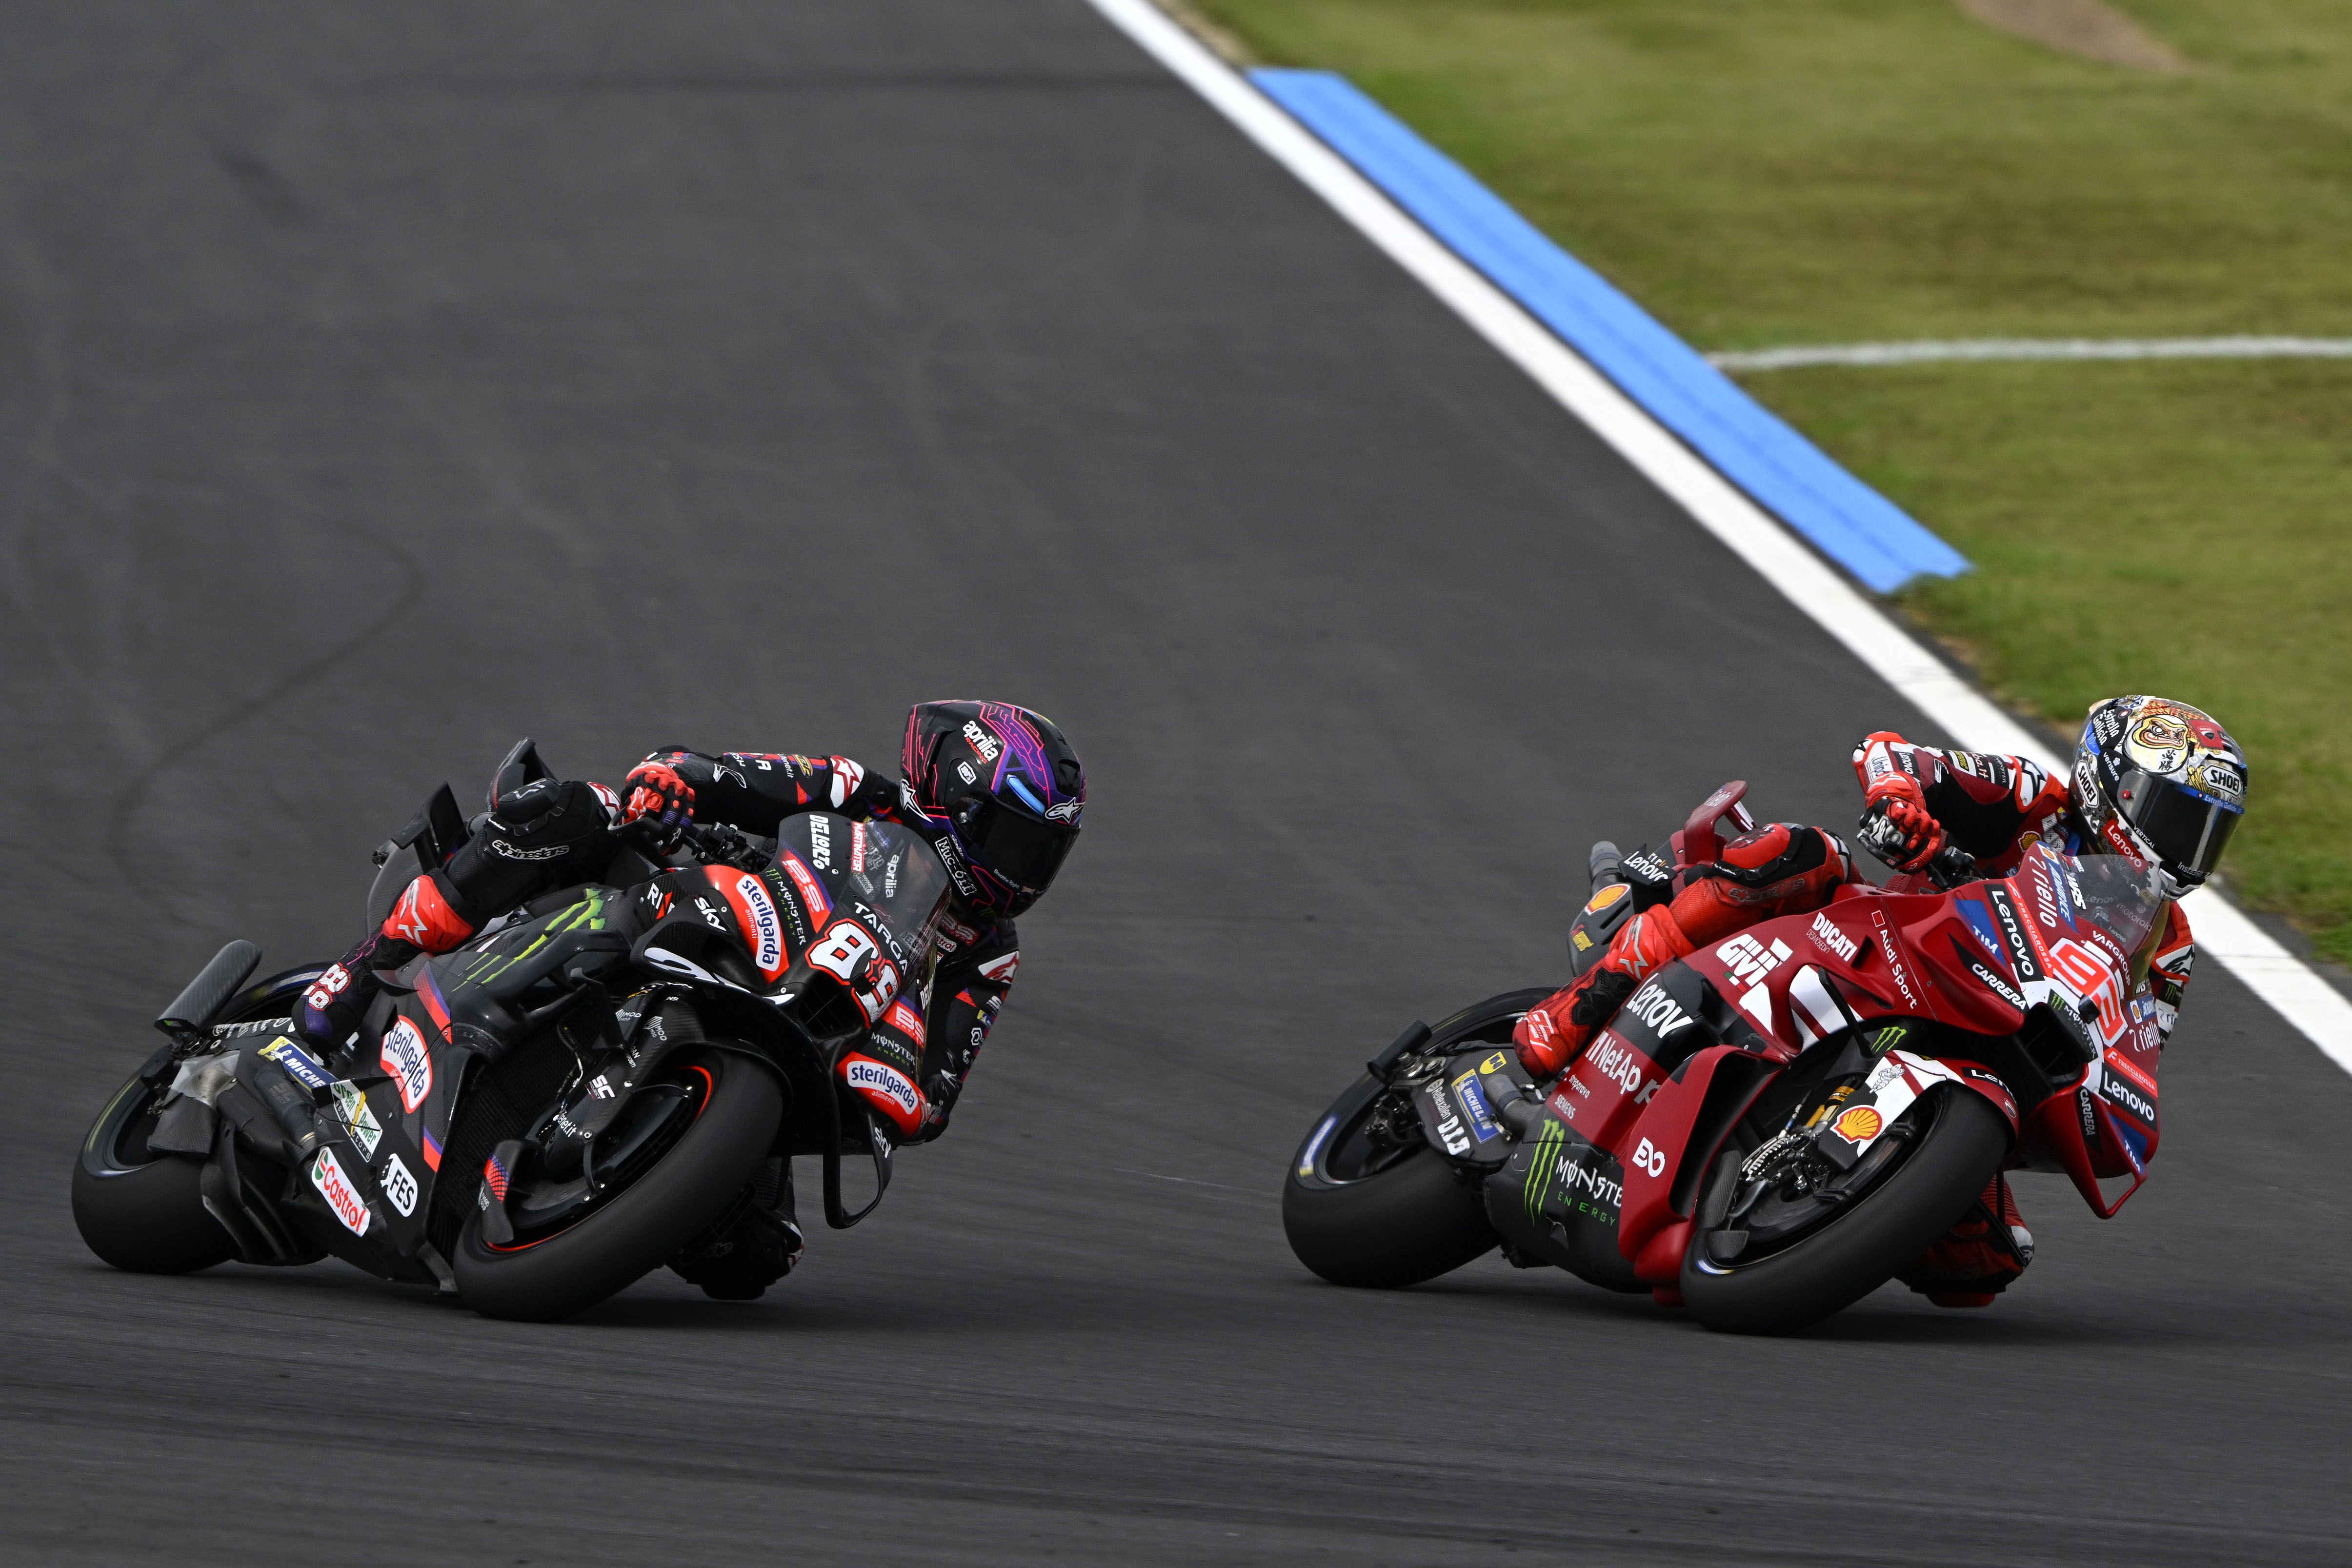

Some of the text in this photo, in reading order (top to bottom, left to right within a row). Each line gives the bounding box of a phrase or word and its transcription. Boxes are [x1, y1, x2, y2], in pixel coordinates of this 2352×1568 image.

[963, 720, 999, 762] aprilia
[965, 738, 988, 764] RACING
[2077, 765, 2097, 802] SHOEI
[2103, 751, 2119, 781] verisure
[2210, 769, 2240, 792] SHOEI
[492, 839, 570, 860] alpinestars
[2108, 824, 2143, 868] Lenovo
[2133, 827, 2155, 849] VERTICAL
[885, 854, 900, 898] aprilia
[2032, 867, 2057, 927] riello
[742, 879, 780, 965] sterilgarda
[745, 908, 759, 939] alimenti
[777, 880, 806, 945] MONSTER
[1991, 891, 2034, 976] Lenovo
[1806, 929, 1830, 954] DESMOSEDICI
[1812, 912, 1858, 962] DUCATI
[1972, 925, 1998, 954] TIM
[2019, 903, 2052, 968] FRECCIAROSSA
[1880, 929, 1917, 1009] Audi Sport
[2092, 930, 2130, 986] VARGROUP
[1971, 963, 2026, 1010] CARRERA
[385, 1026, 425, 1098] sterilgarda
[871, 1032, 915, 1065] MONSTER
[285, 1058, 326, 1087] MICHE
[851, 1065, 915, 1108] sterilgarda
[2118, 1059, 2155, 1090] FRECCIAROSSA
[1464, 1087, 1493, 1130] MICHELIN
[1555, 1094, 1576, 1119] SIEMENS
[2080, 1088, 2096, 1136] CARRERA
[2104, 1071, 2154, 1121] Lenovo
[358, 1112, 376, 1145] Power
[2125, 1140, 2140, 1172] TIM
[324, 1166, 366, 1232] Castrol
[390, 1169, 414, 1210] FES
[1556, 1156, 1623, 1208] MONSTE
[1558, 1191, 1616, 1227] ENERGY
